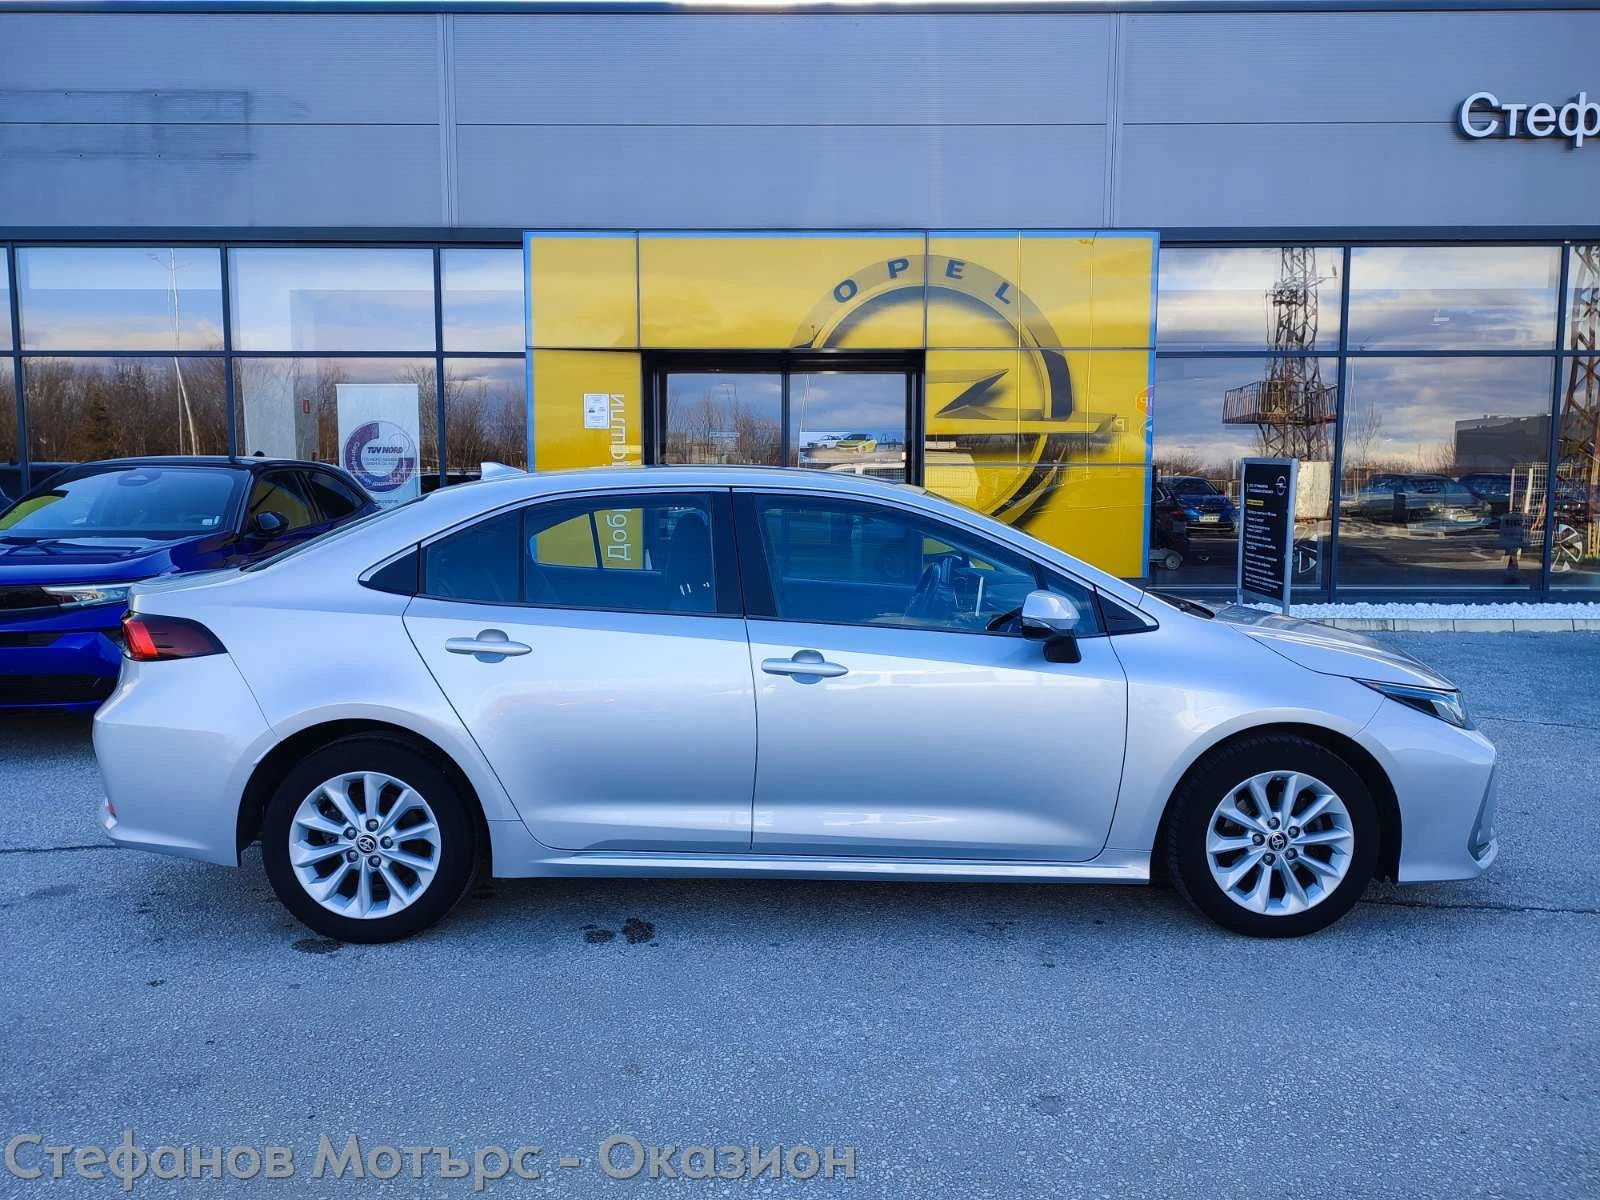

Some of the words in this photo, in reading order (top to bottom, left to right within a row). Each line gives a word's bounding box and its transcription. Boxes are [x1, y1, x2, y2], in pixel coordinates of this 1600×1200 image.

[1460, 91, 1600, 148] Стеф
[833, 258, 1013, 304] OPEL
[382, 446, 403, 454] NORD
[610, 393, 626, 469] ошли
[607, 508, 632, 561] Доб
